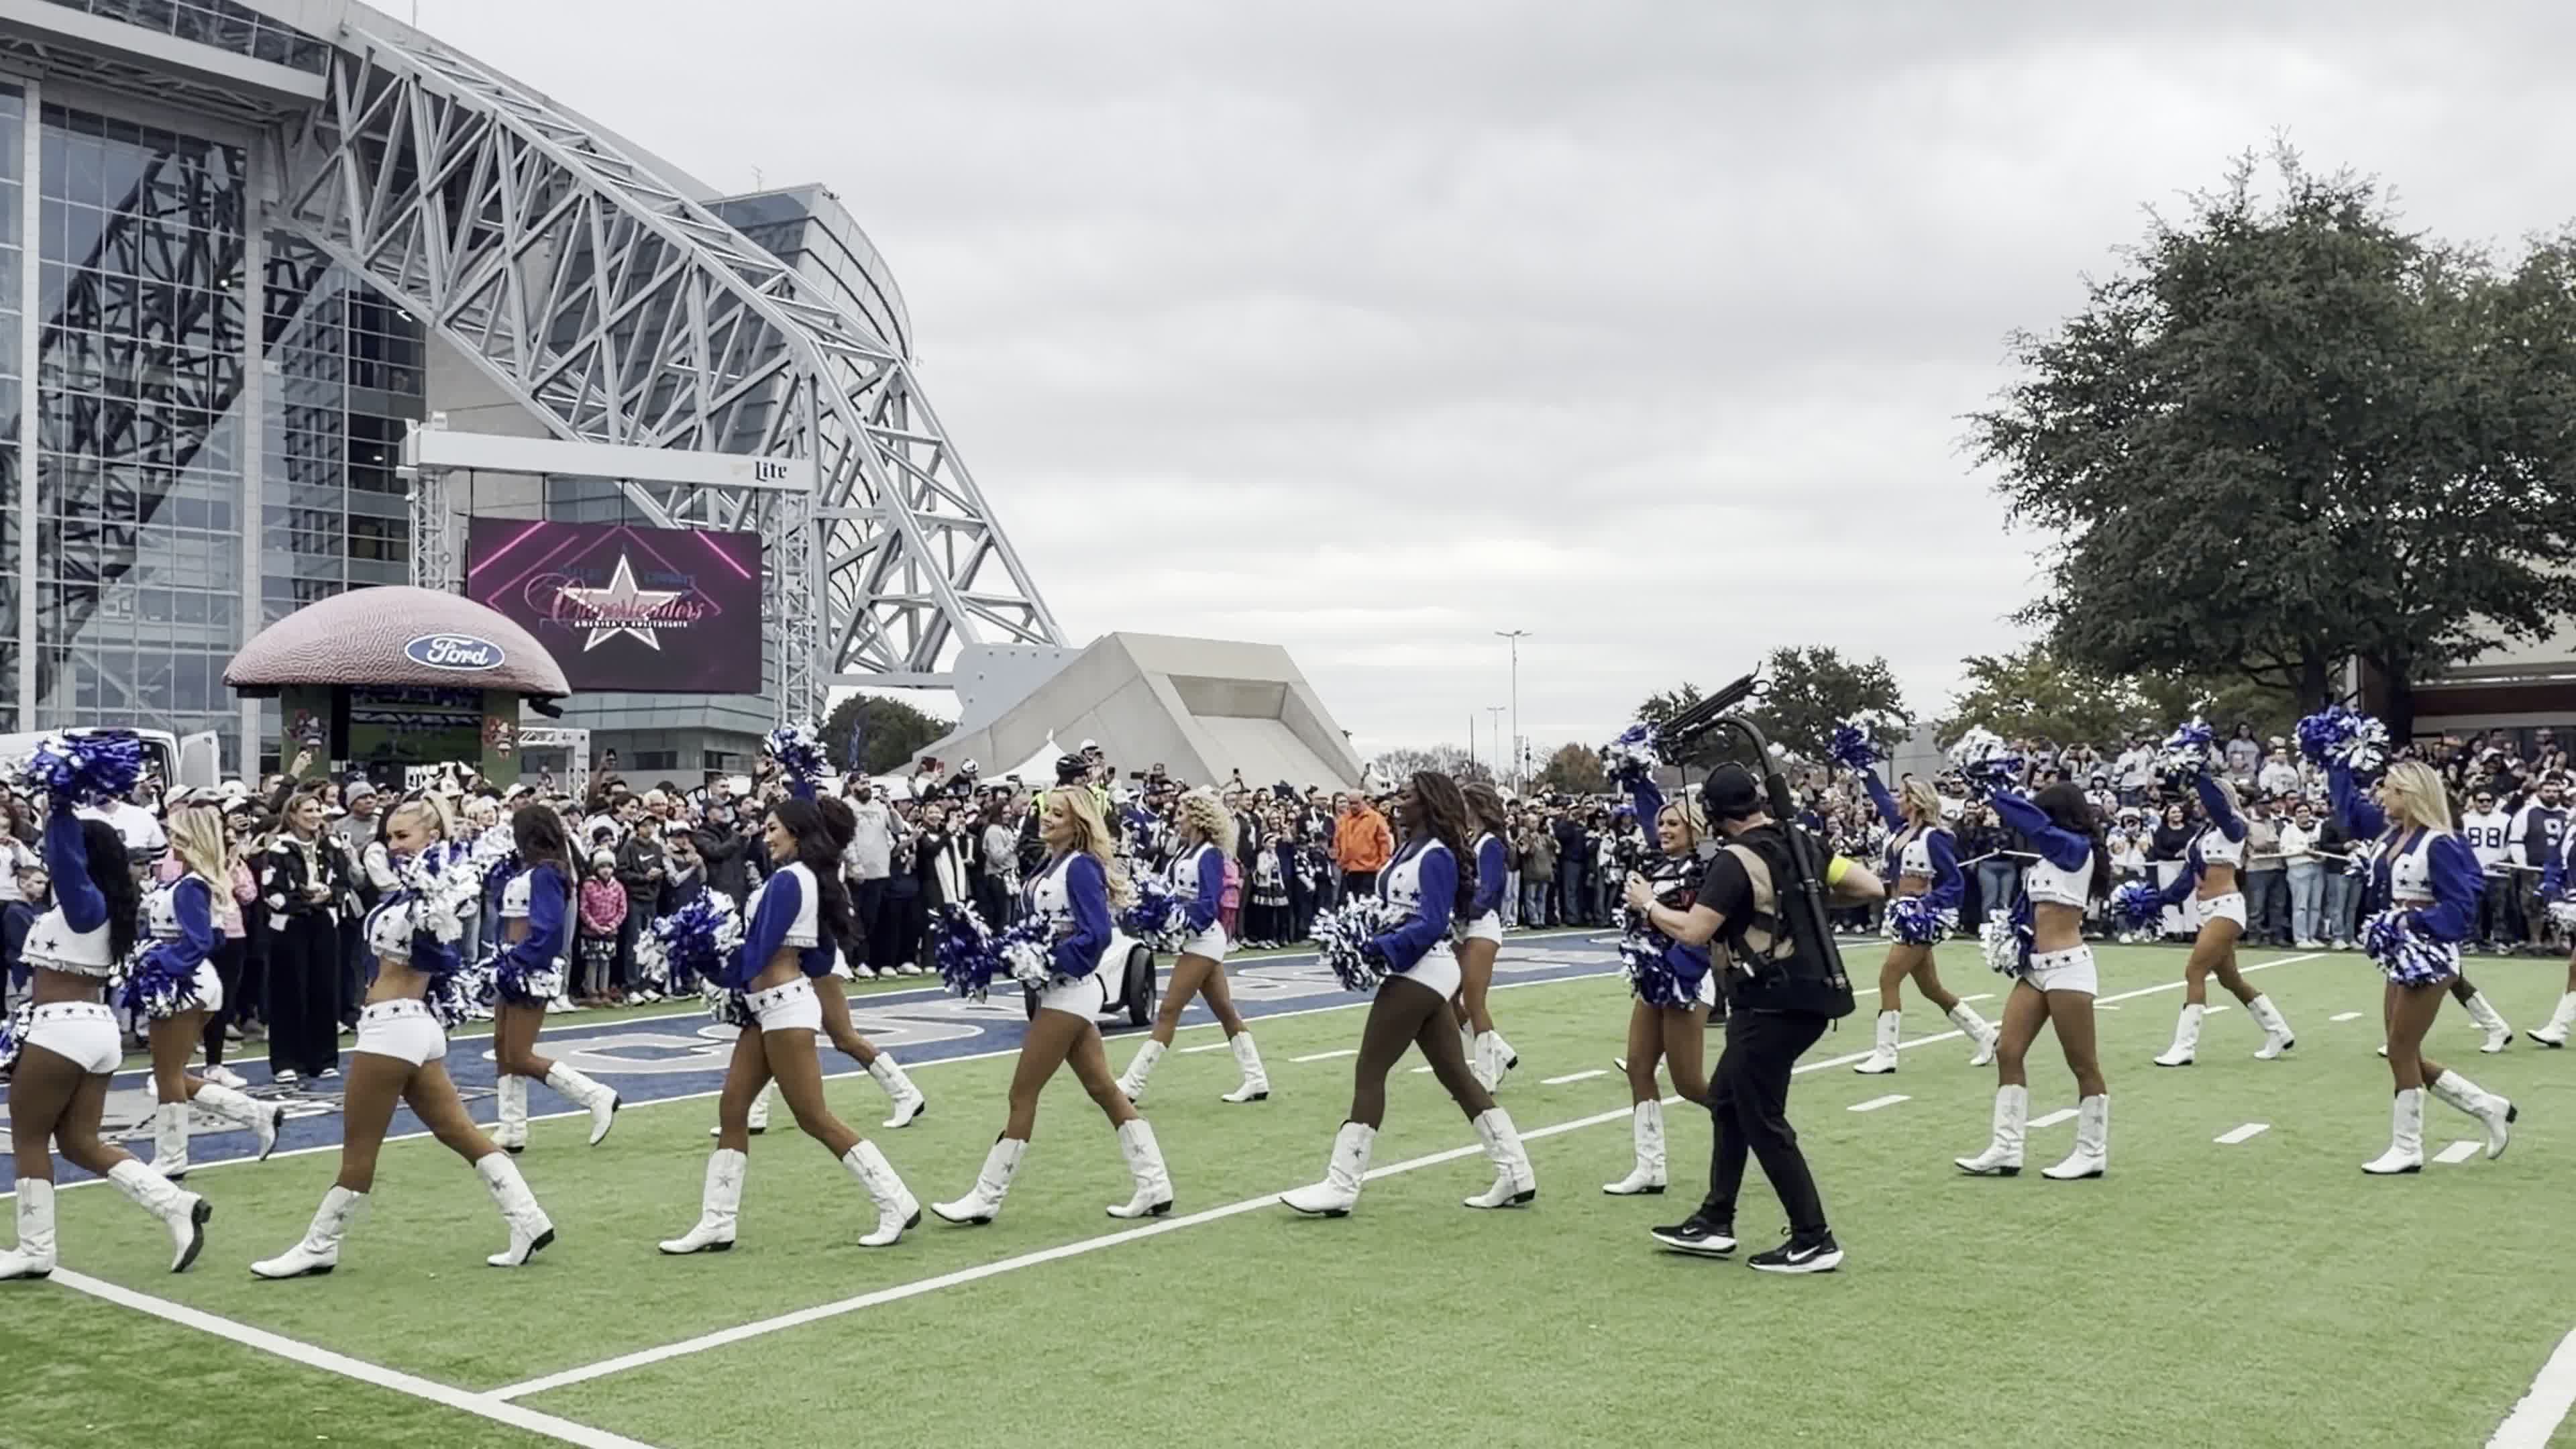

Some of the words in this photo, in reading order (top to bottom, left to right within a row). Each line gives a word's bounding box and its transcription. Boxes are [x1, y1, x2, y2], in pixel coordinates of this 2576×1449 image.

[755, 461, 787, 482] Lite
[427, 637, 488, 665] Ford
[2469, 826, 2501, 848] 88
